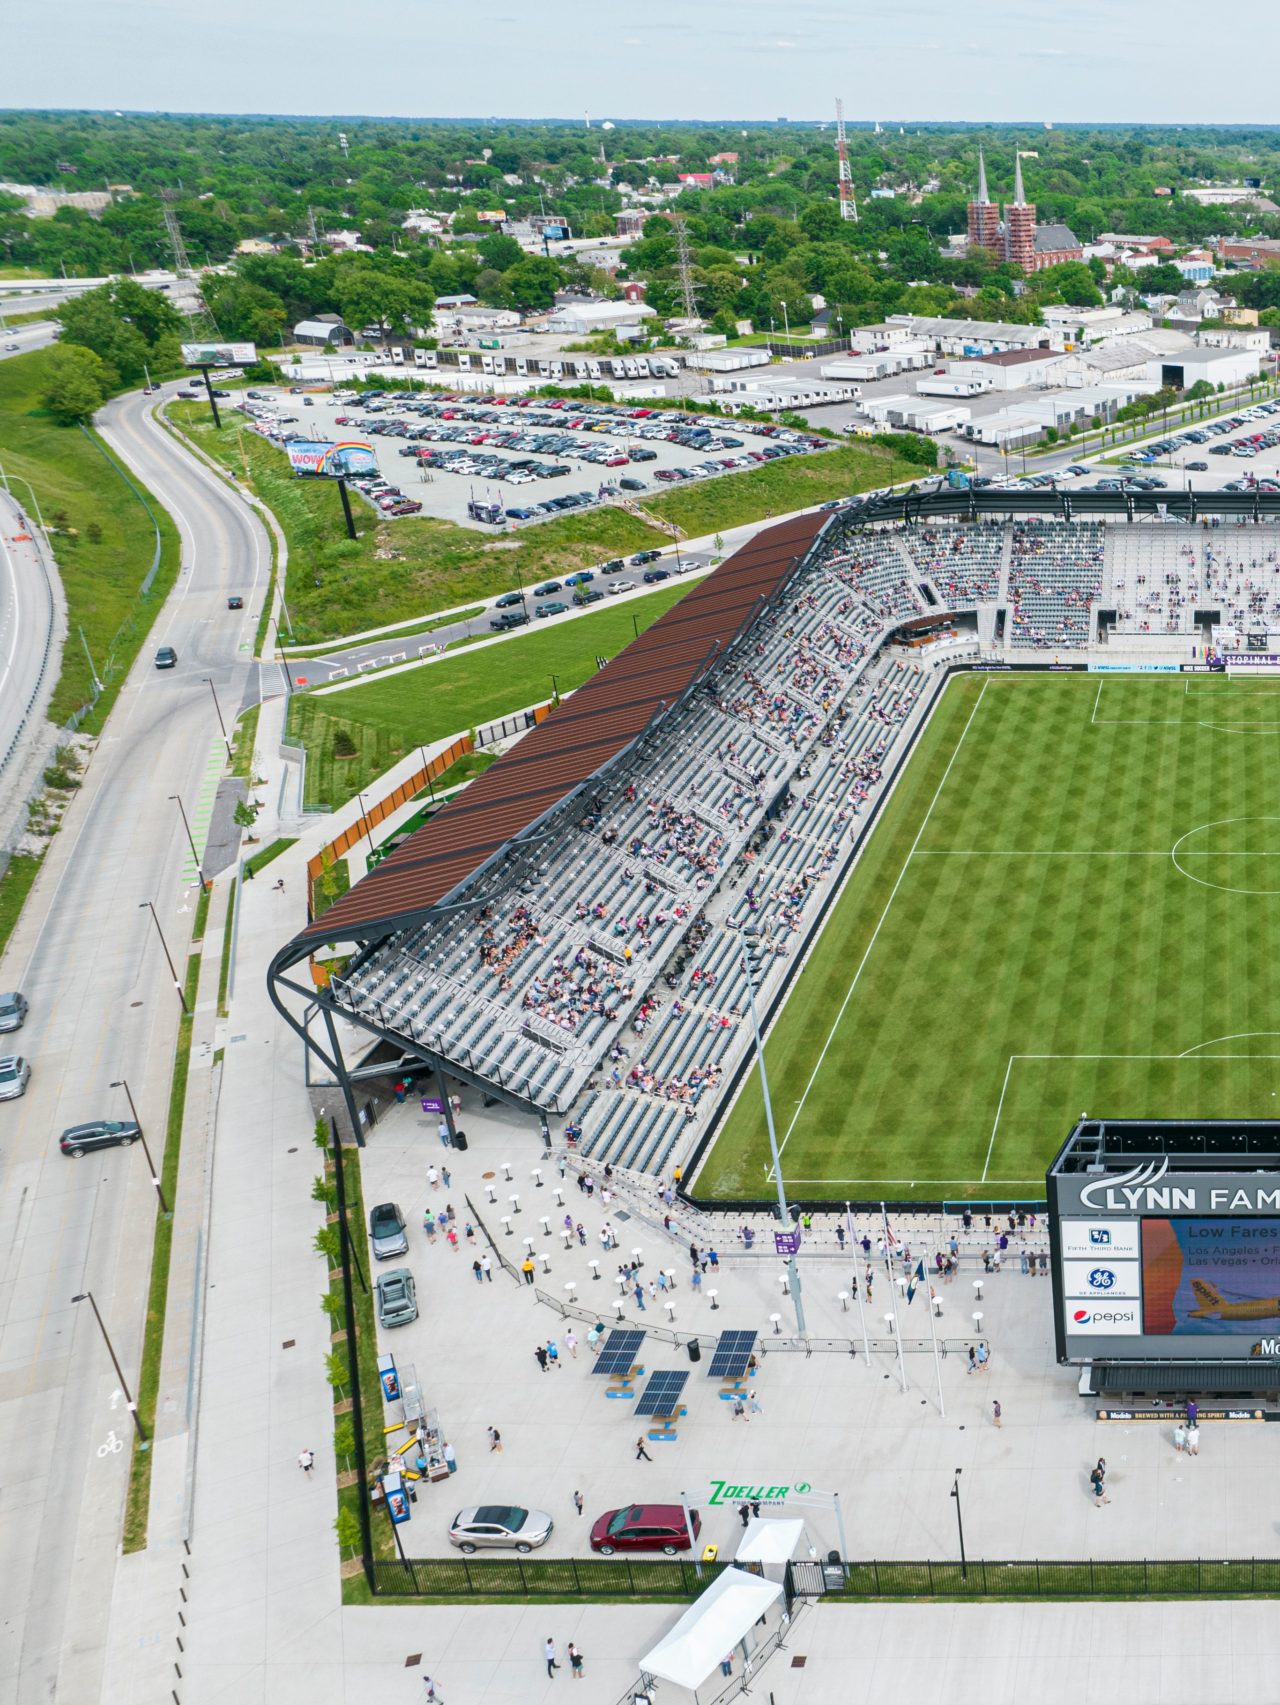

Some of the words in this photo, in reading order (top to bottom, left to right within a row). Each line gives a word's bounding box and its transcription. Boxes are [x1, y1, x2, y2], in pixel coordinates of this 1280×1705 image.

[1220, 655, 1271, 665] ESTOPINAL
[1188, 1226, 1224, 1238] Low
[1231, 1226, 1278, 1238] Fares
[1188, 1246, 1210, 1255] Los
[1213, 1246, 1260, 1257] Angeles
[1188, 1257, 1208, 1266] Las
[1211, 1257, 1248, 1267] Vegas
[1093, 1312, 1134, 1324] pepsi
[1110, 1411, 1132, 1419] Modelo
[708, 1480, 790, 1505] ZOELLER
